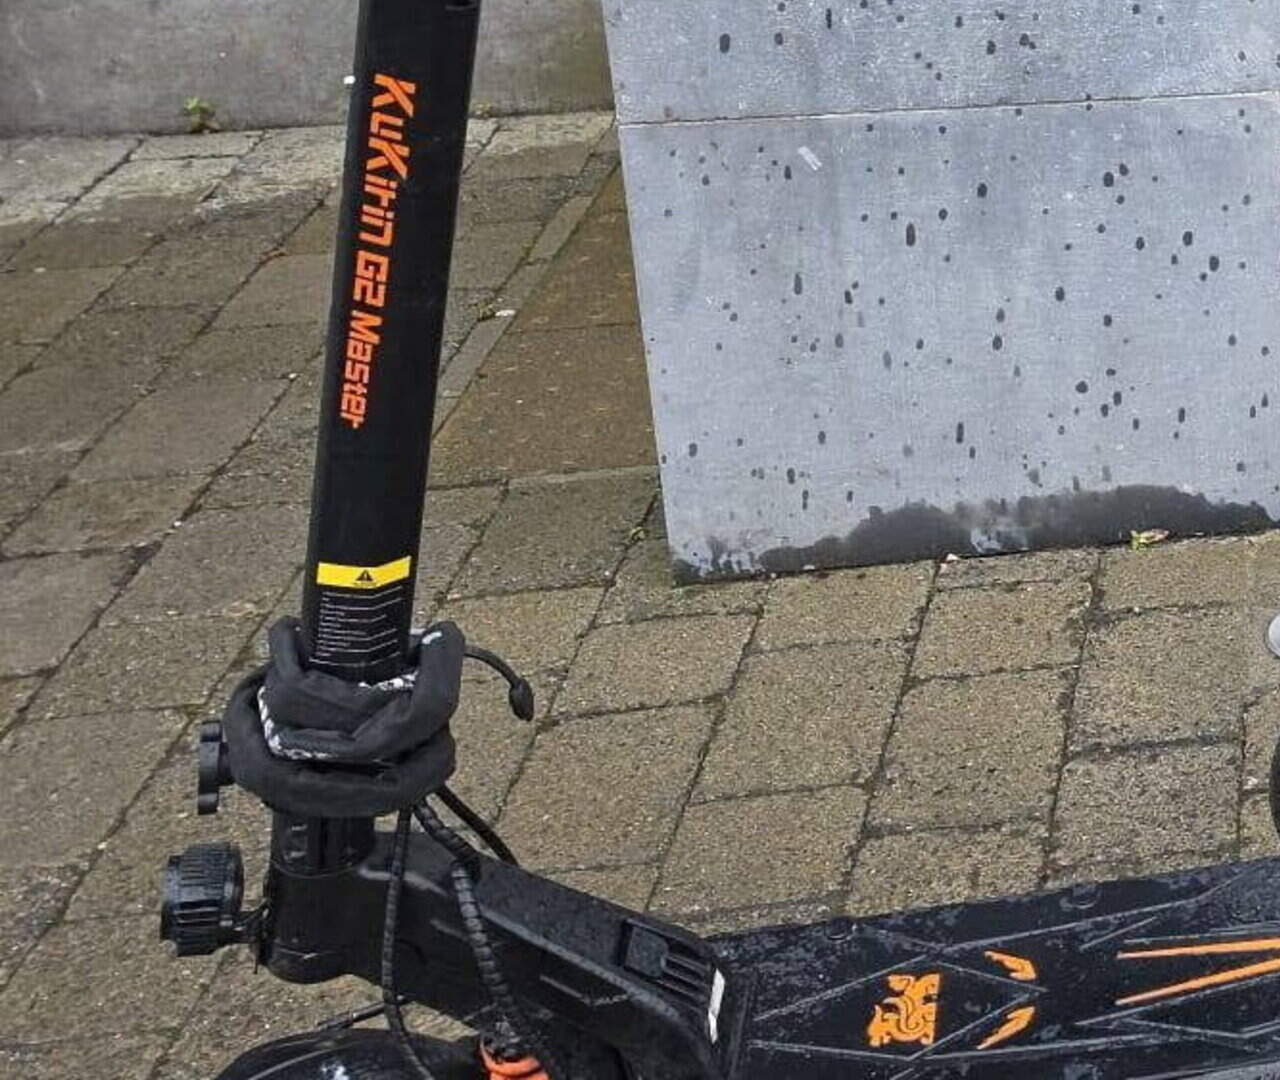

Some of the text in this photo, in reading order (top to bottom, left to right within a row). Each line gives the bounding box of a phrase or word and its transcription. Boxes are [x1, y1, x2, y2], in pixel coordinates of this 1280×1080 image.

[340, 73, 416, 429] KuKirin G2 Master
